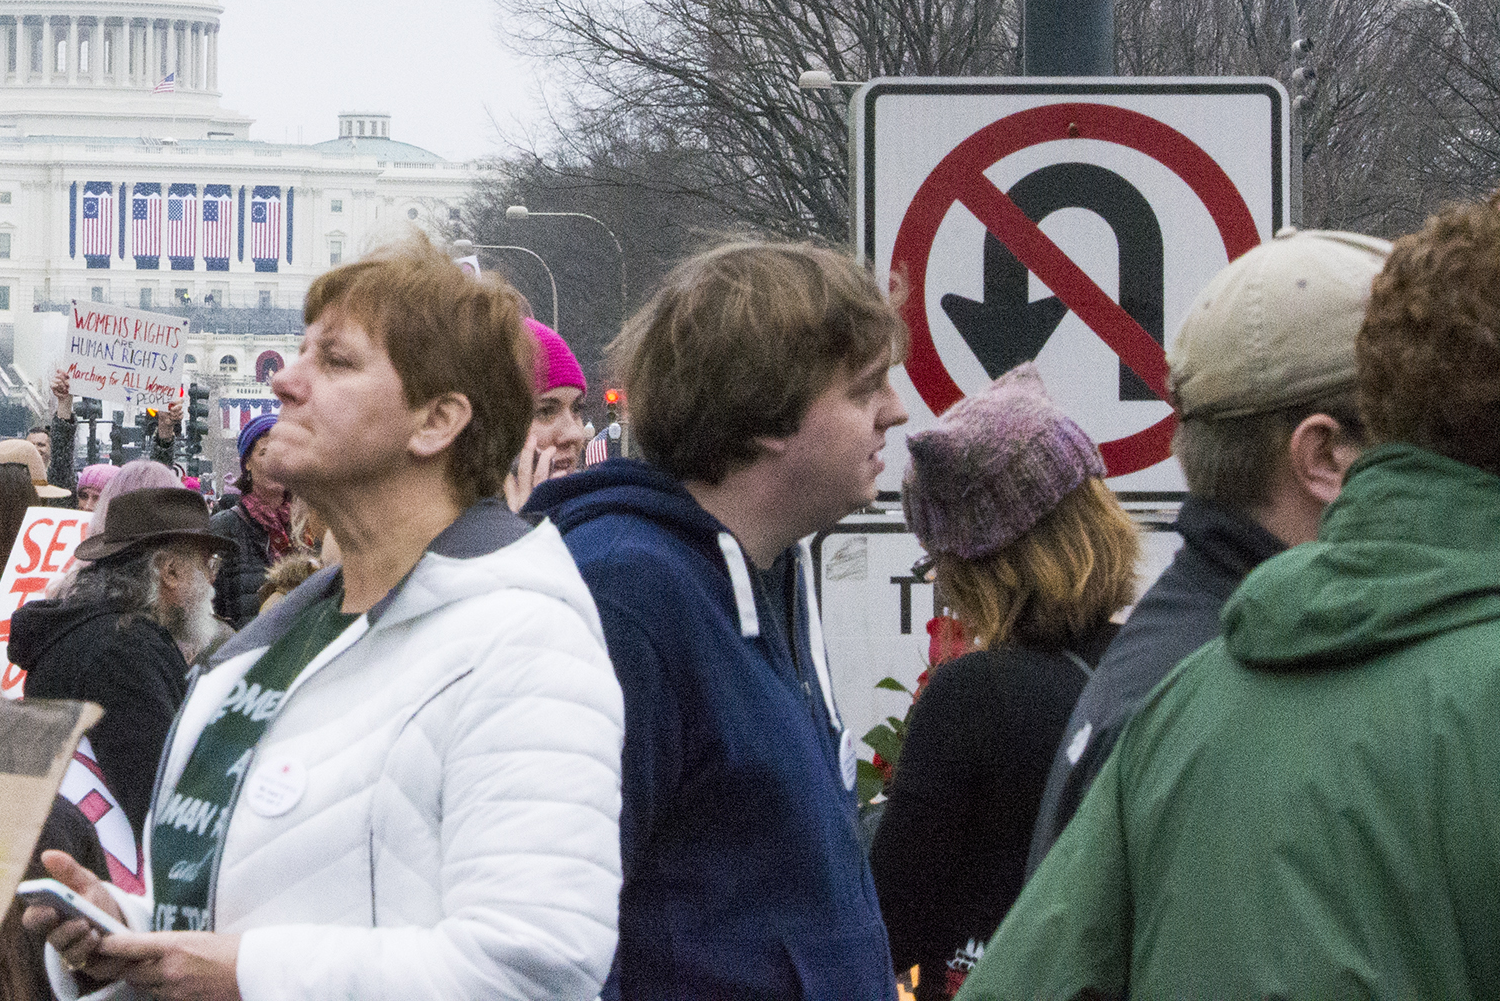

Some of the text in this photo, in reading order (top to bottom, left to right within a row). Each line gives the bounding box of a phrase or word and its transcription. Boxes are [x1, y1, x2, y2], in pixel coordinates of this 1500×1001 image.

[74, 308, 181, 349] WOMENS RIGHTS
[71, 336, 179, 374] HUMAN RIGHTS!
[67, 363, 106, 391] Marching
[121, 372, 140, 389] ALL
